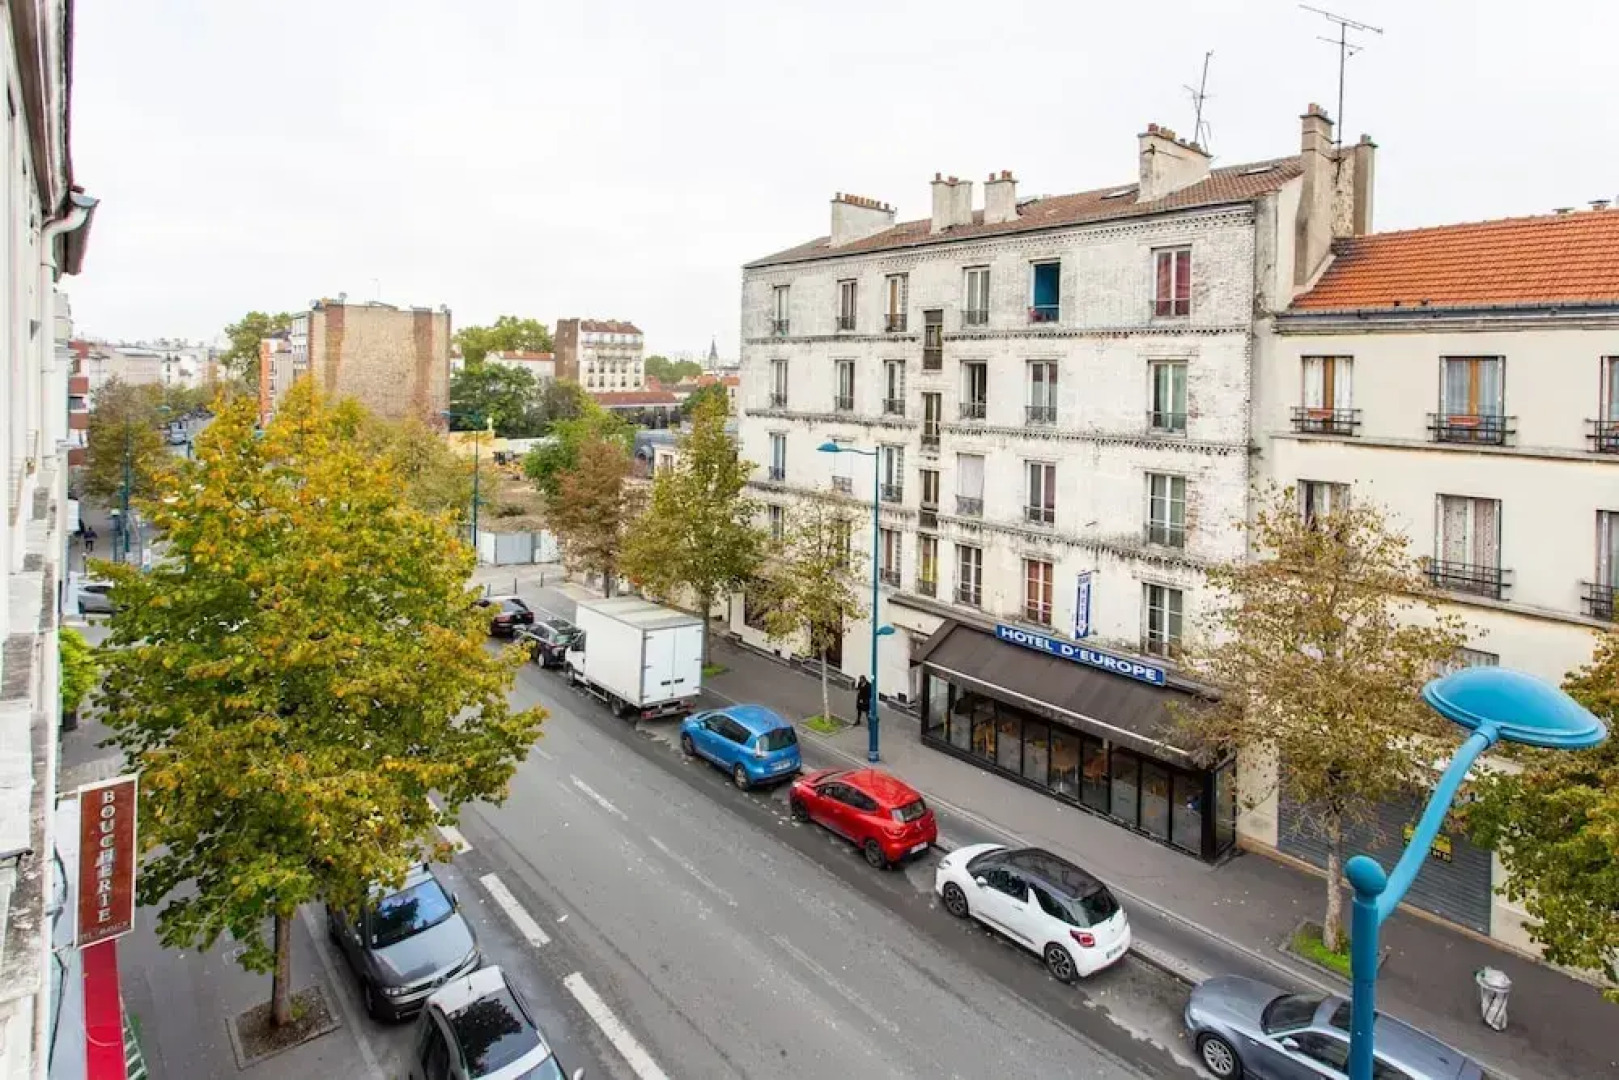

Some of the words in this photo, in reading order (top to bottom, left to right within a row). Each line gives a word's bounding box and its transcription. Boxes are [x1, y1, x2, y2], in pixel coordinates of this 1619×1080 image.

[1001, 627, 1052, 650] HOTEL
[1061, 645, 1157, 682] D'EUROPE
[95, 791, 116, 922] BOUCHERIE
